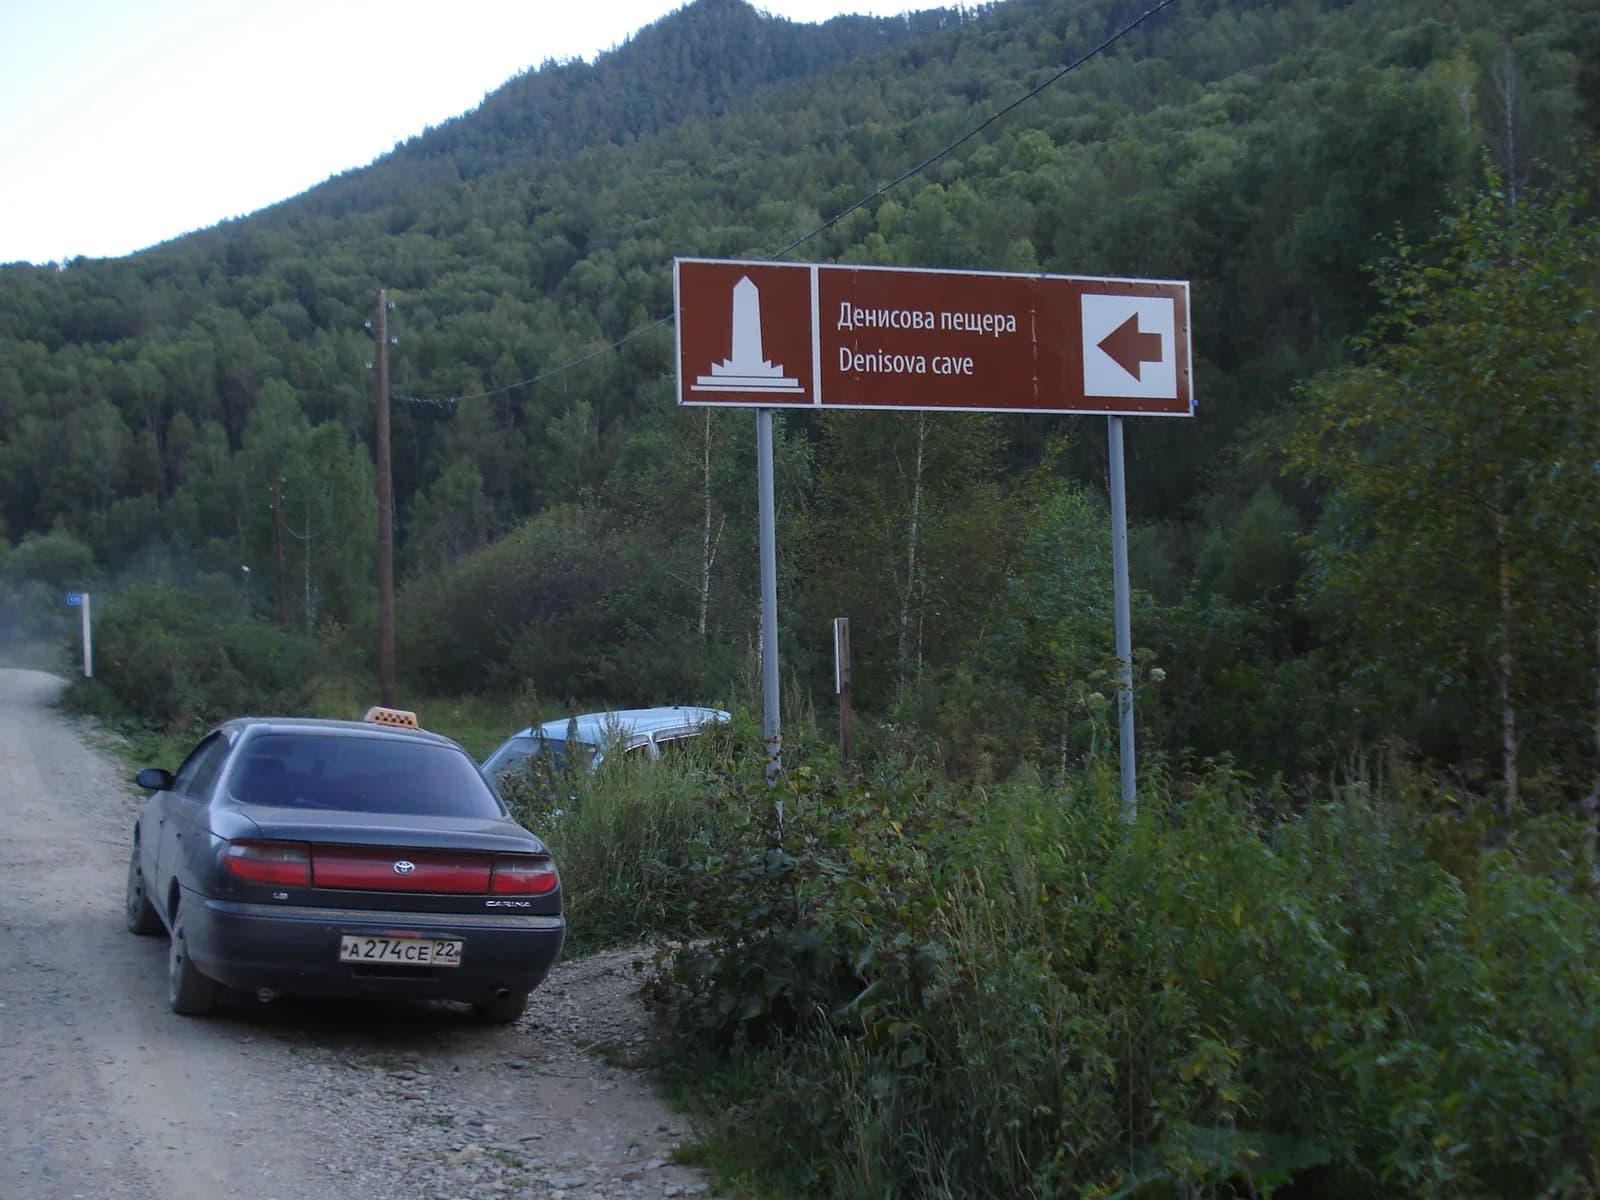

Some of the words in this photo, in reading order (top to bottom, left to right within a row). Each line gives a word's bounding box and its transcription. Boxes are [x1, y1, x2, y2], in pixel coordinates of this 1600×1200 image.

[837, 301, 935, 331] Денисова
[940, 311, 1017, 338] пещера
[839, 347, 926, 374] Denisova
[932, 355, 974, 375] cave
[435, 942, 455, 957] 22
